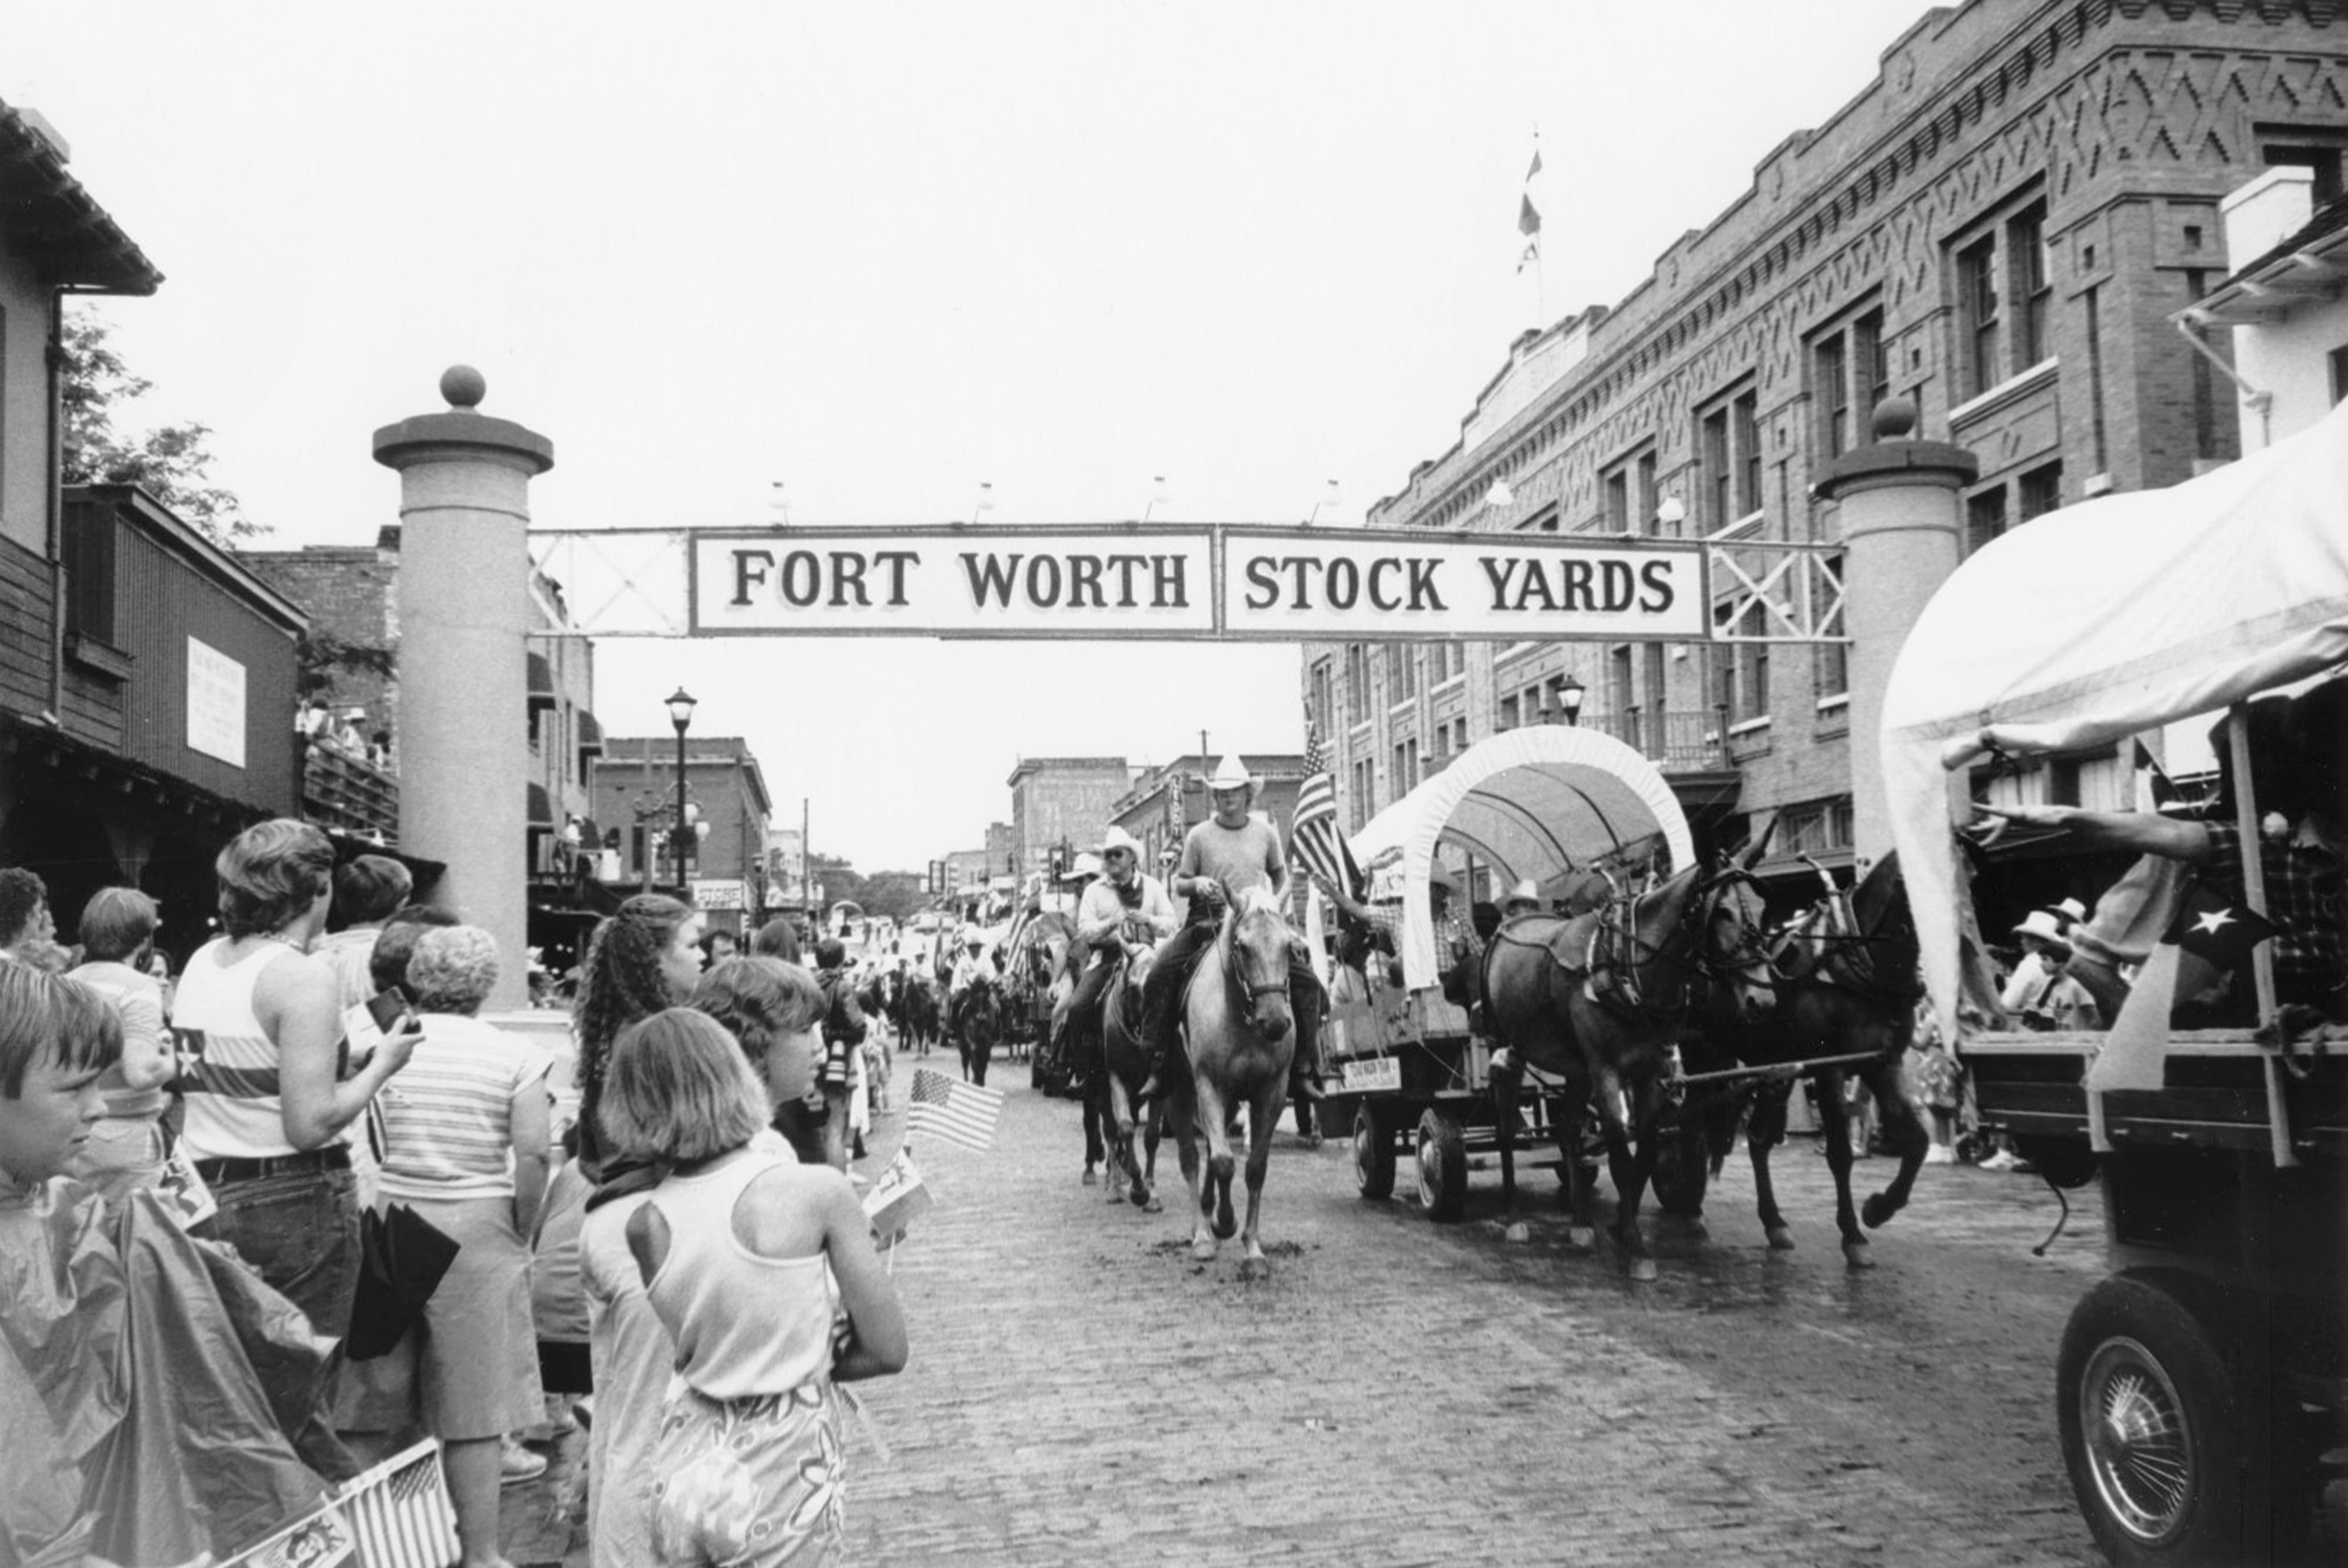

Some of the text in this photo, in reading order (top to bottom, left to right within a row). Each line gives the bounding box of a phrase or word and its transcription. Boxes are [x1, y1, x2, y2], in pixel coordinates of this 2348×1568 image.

[731, 550, 1675, 613] FORT WORTH STOCK YARDS
